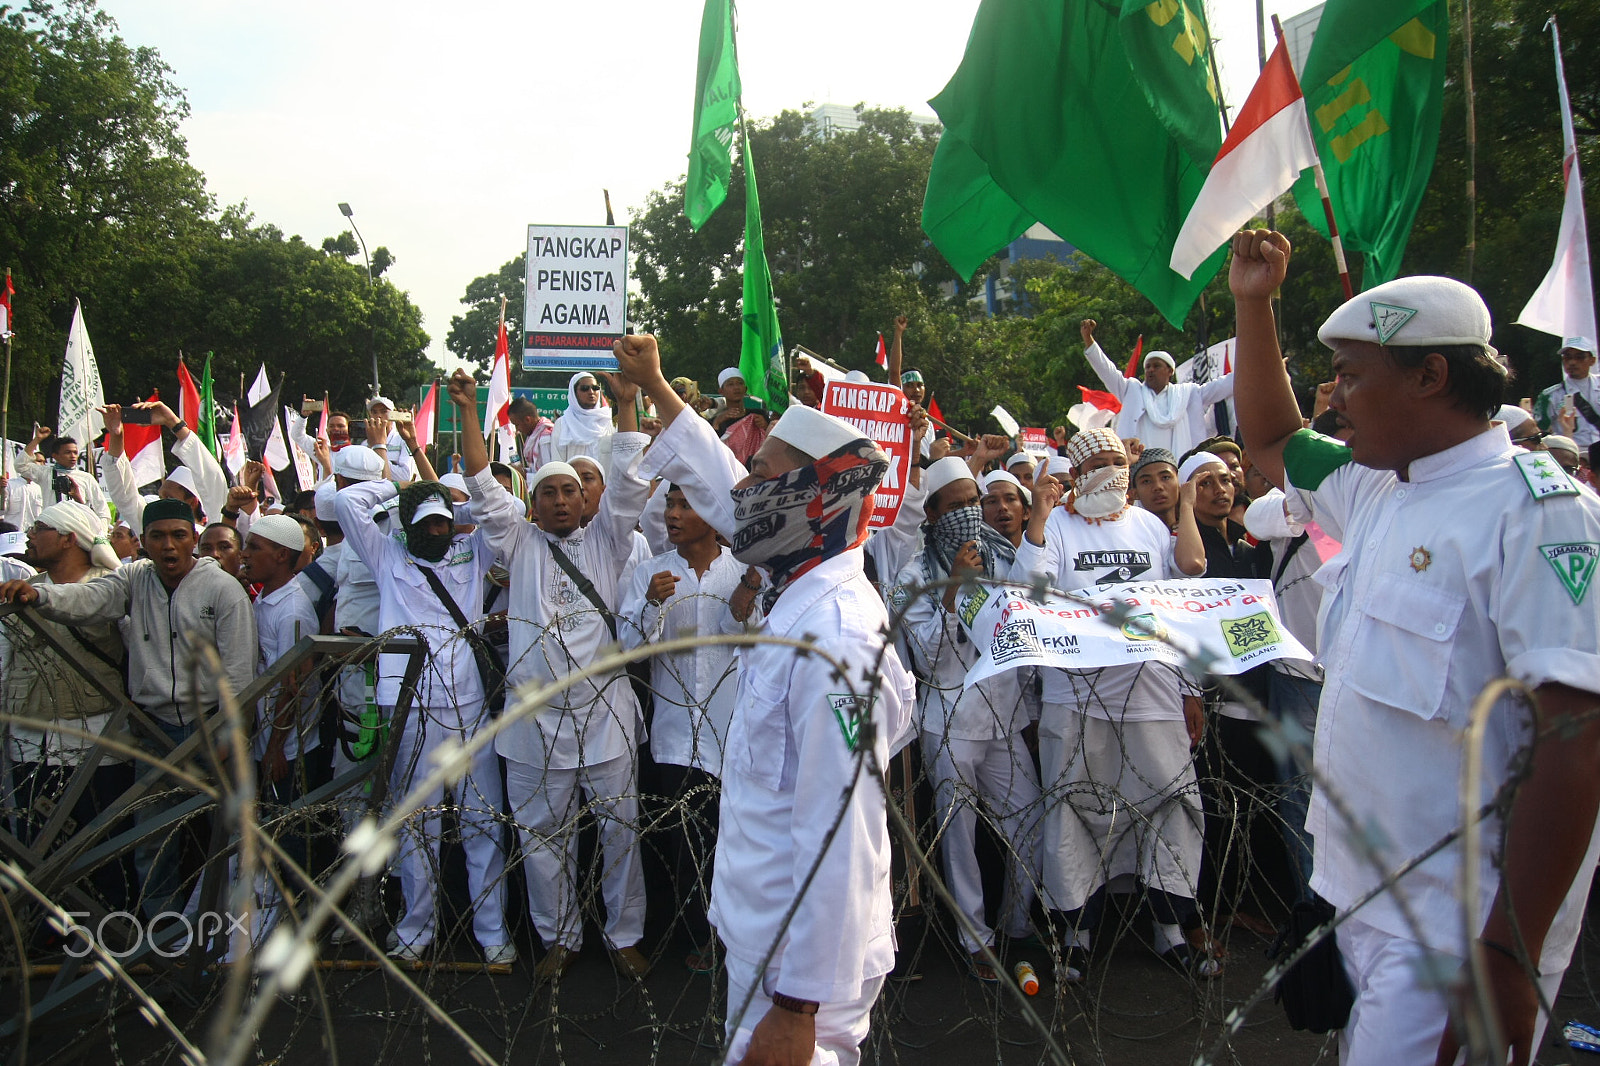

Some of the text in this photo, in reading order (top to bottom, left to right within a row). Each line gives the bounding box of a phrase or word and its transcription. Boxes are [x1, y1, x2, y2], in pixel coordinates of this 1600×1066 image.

[532, 236, 622, 259] TANGKAP
[537, 269, 616, 292] PENISTA
[539, 303, 611, 326] AGAMA
[535, 335, 589, 347] PENJARAKAN
[832, 386, 908, 414] TANGKAP &
[1540, 484, 1570, 494] LPI
[1083, 553, 1149, 565] AL-QUR'AN
[1121, 582, 1246, 598] Toleransi
[1040, 597, 1141, 619] Penisa
[1042, 635, 1079, 649] FKM
[1044, 647, 1081, 655] MALANG
[1240, 645, 1277, 663] MALANG
